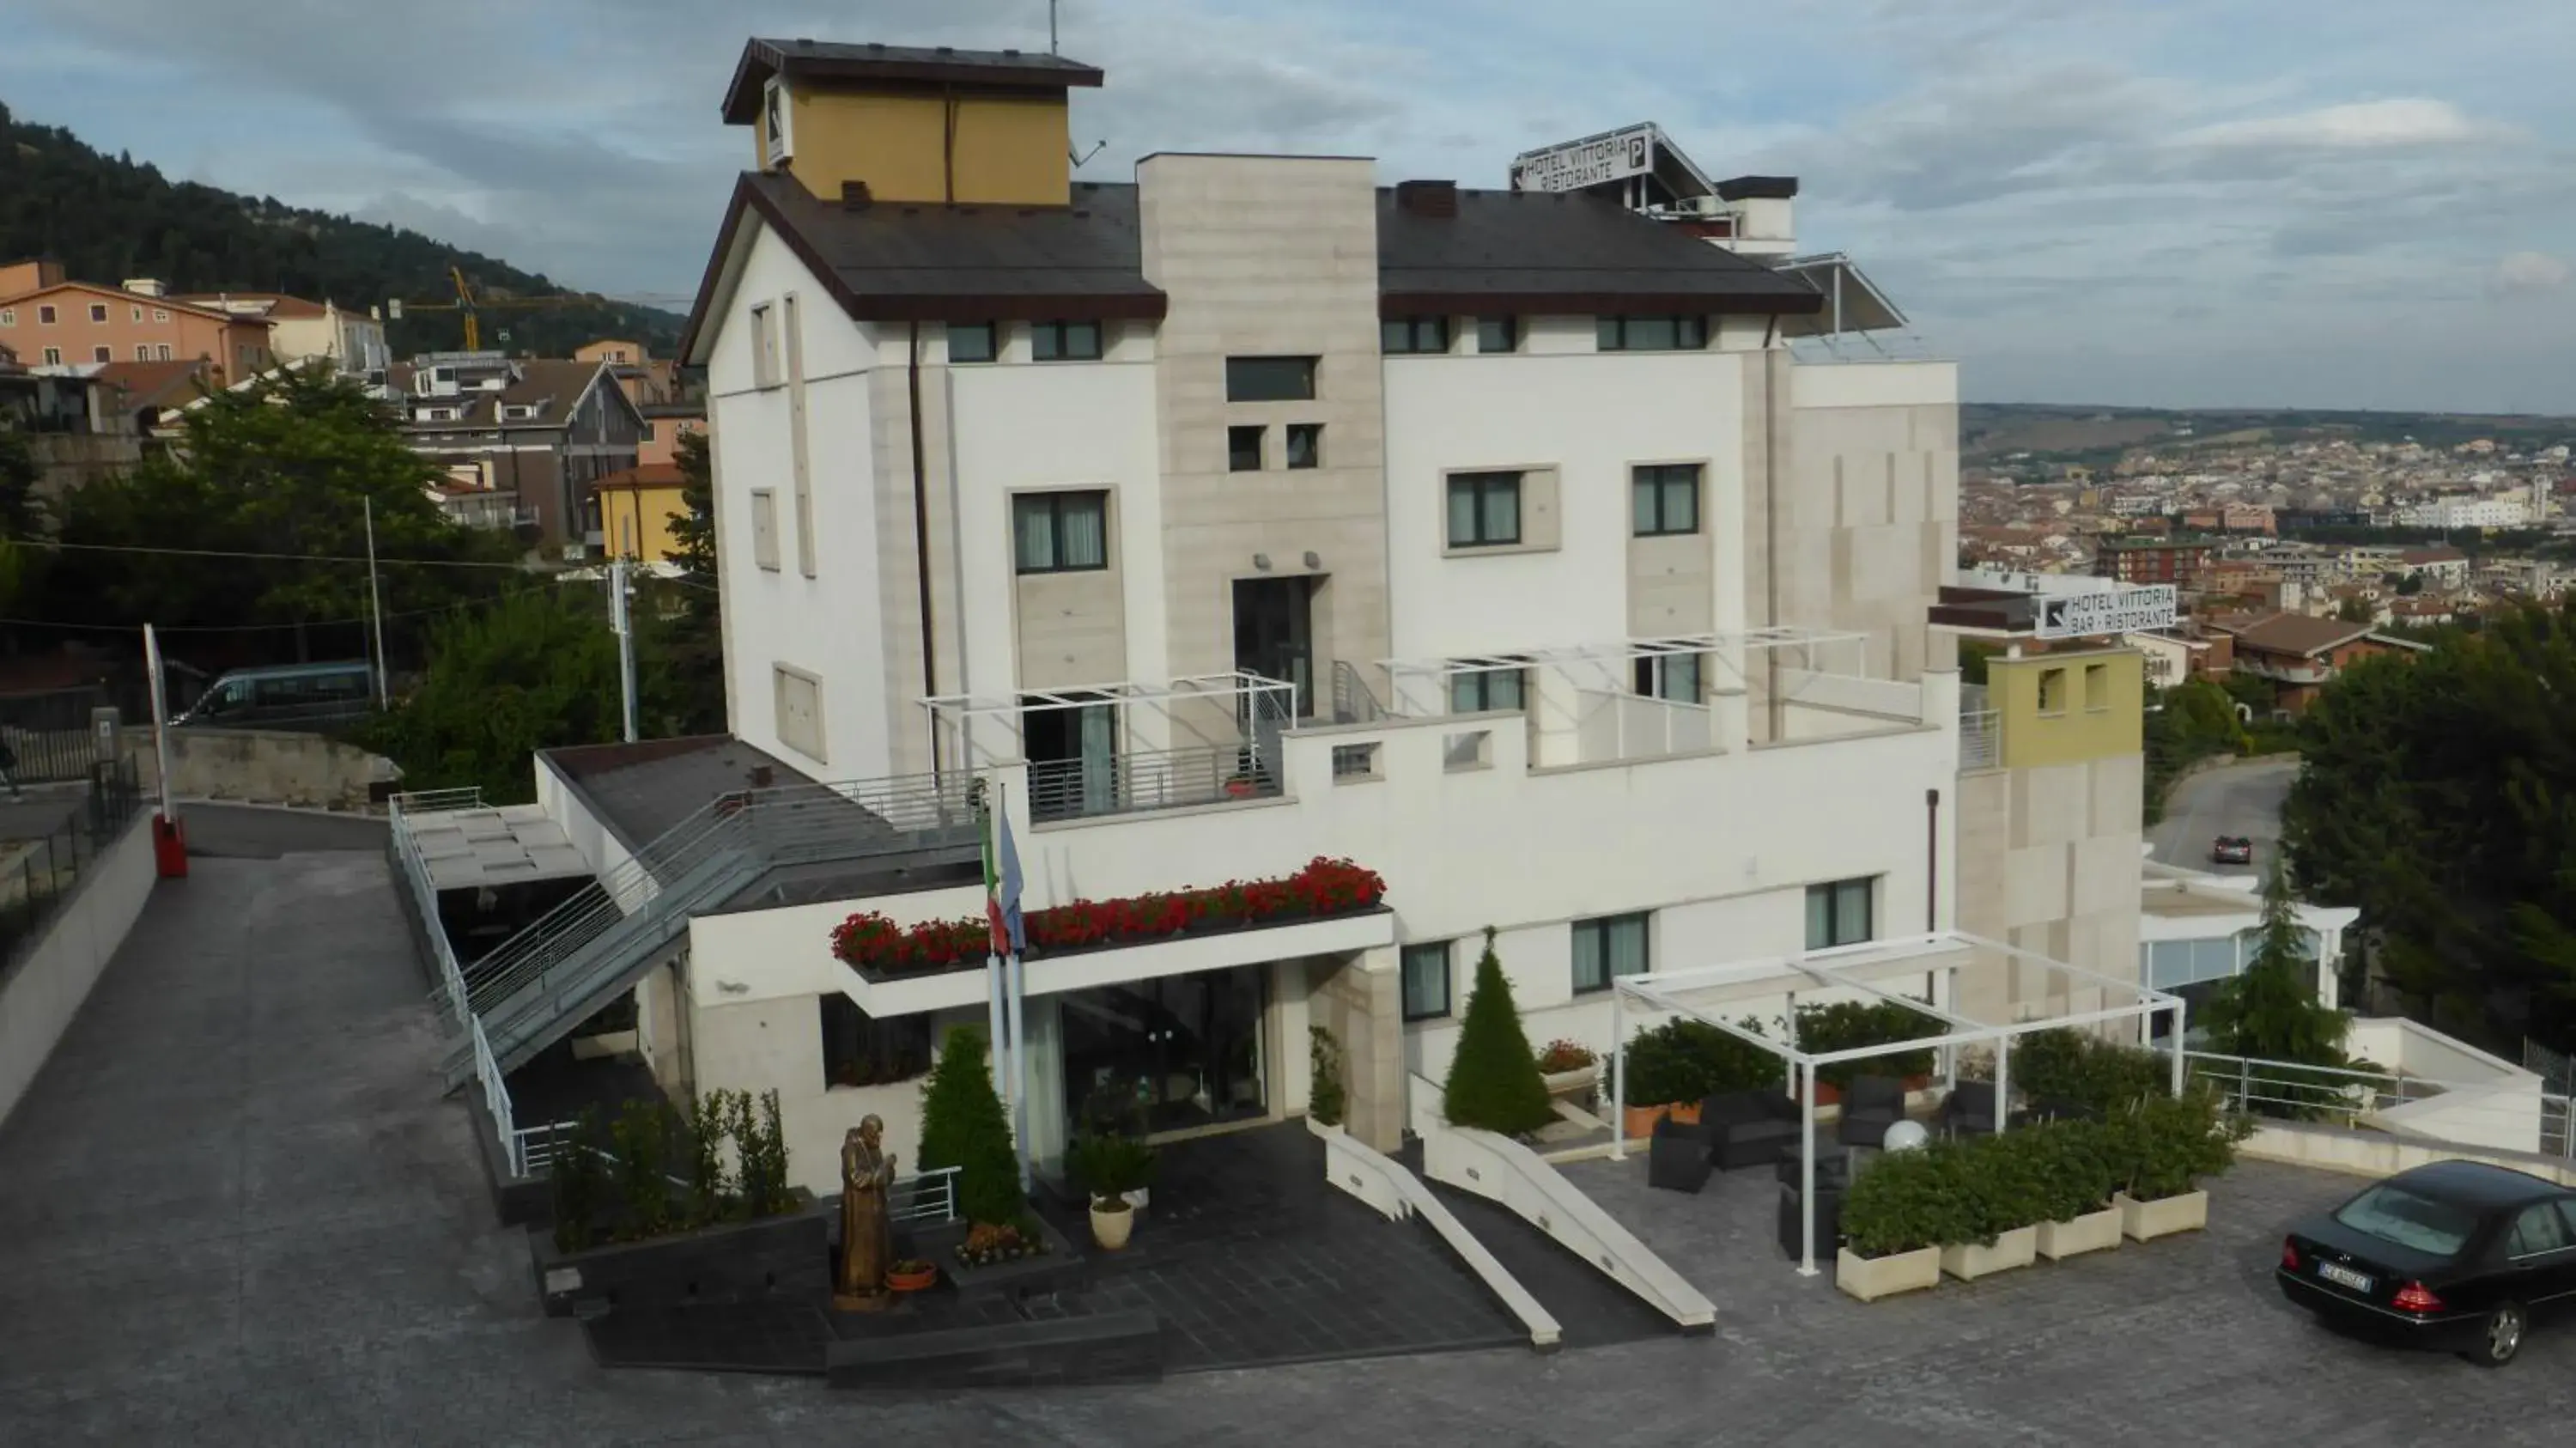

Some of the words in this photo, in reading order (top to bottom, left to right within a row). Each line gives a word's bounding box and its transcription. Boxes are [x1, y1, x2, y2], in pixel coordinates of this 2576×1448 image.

[1526, 155, 1566, 176] HOTEL
[1570, 138, 1627, 165] VITTORIA
[1631, 139, 1643, 167] P
[1540, 162, 1613, 191] RISTORANTE
[2072, 594, 2113, 612] HOTEL
[2118, 588, 2173, 607] VITTORIA
[2072, 617, 2094, 633] BAR
[2105, 609, 2173, 630] RISTORANTE
